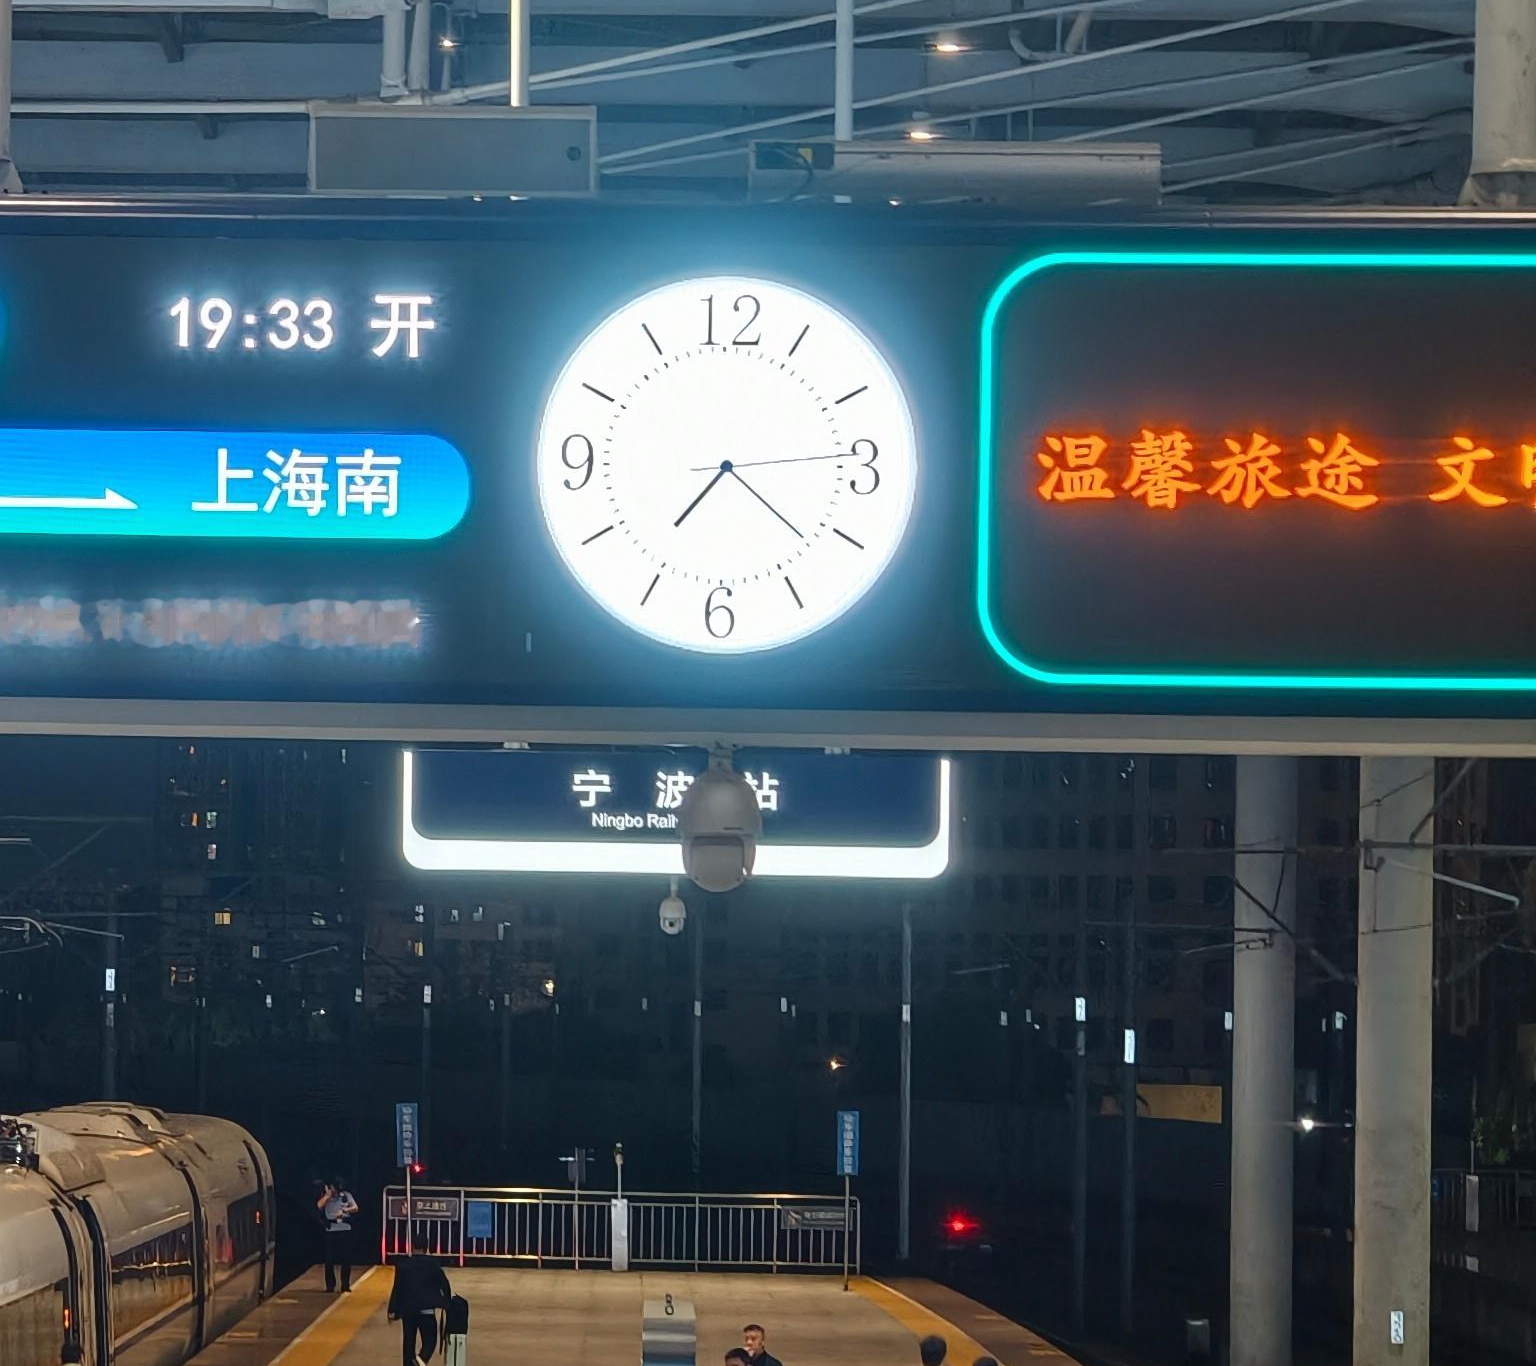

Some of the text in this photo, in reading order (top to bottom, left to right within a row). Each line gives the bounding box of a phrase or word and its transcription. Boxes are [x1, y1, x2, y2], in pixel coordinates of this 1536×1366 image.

[170, 294, 435, 358] 19:33 开
[699, 294, 762, 346] 12
[191, 447, 402, 517] 上海南
[561, 434, 595, 491] 9
[849, 438, 881, 495] 3
[1036, 429, 1536, 511] 温馨旅途 文
[704, 586, 735, 639] 6
[591, 812, 679, 831] Ningbo Rail
